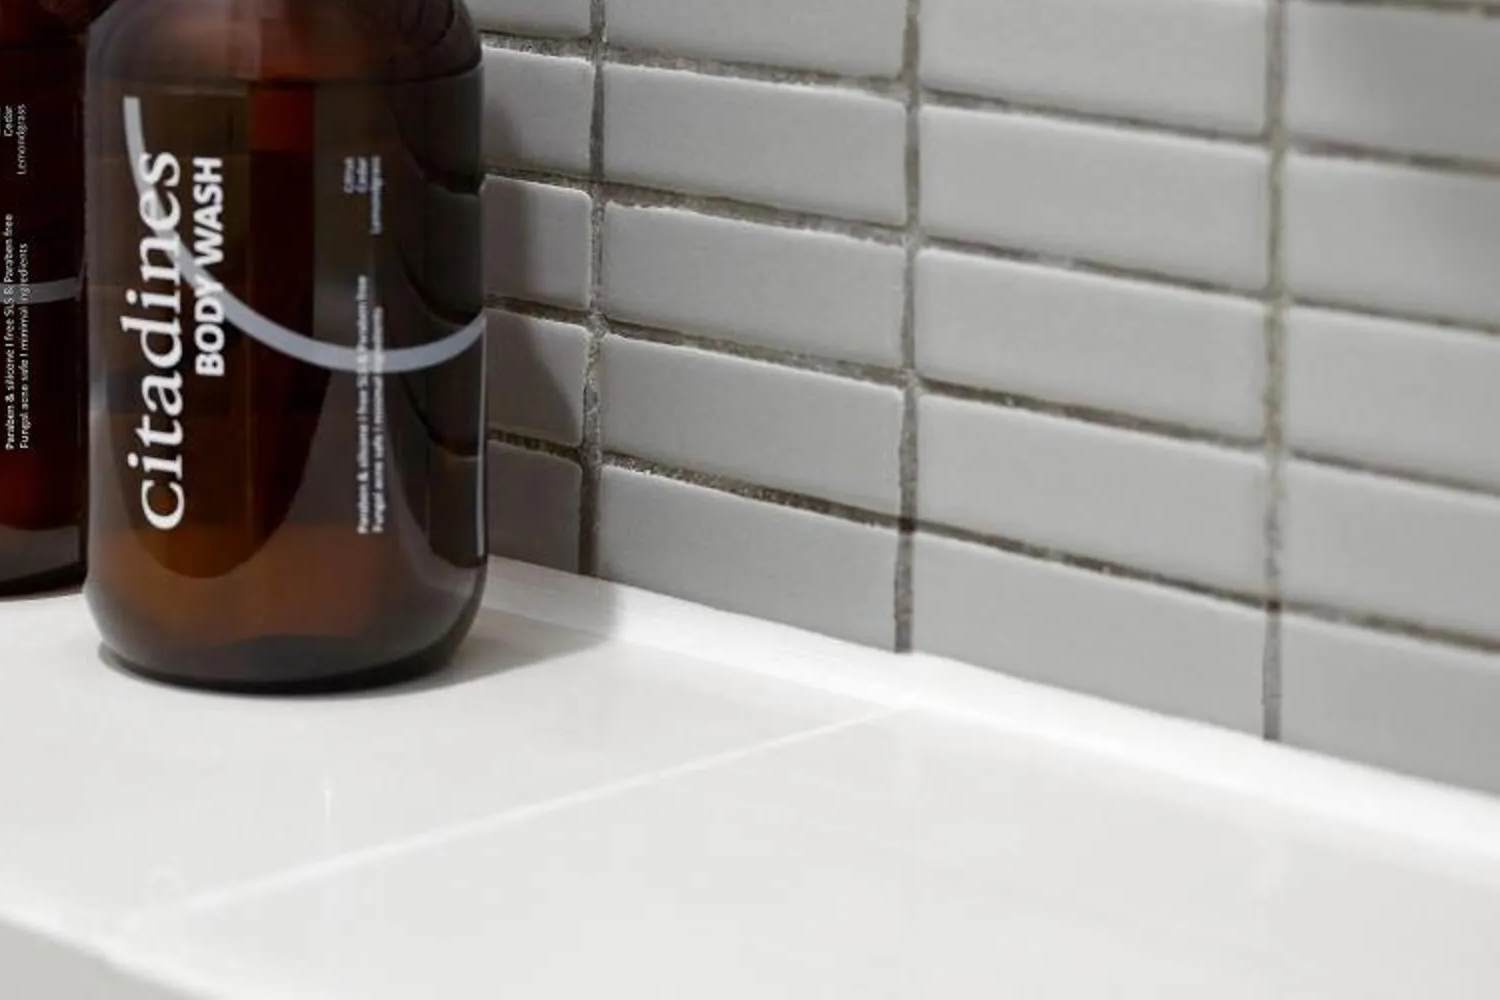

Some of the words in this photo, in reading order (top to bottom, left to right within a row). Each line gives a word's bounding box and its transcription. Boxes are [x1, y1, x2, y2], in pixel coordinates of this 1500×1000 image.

[3, 105, 13, 137] Cedar
[1, 213, 13, 237] free
[193, 157, 224, 265] WASH
[3, 239, 14, 282] Paraben
[3, 297, 15, 317] SLS
[18, 305, 29, 351] minimal
[194, 274, 225, 376] BODY
[3, 319, 15, 341] free
[119, 152, 184, 530] citadines
[3, 349, 15, 391] silicone
[4, 393, 15, 402] &
[4, 405, 15, 450] Paraben
[19, 412, 32, 449] Fungal
